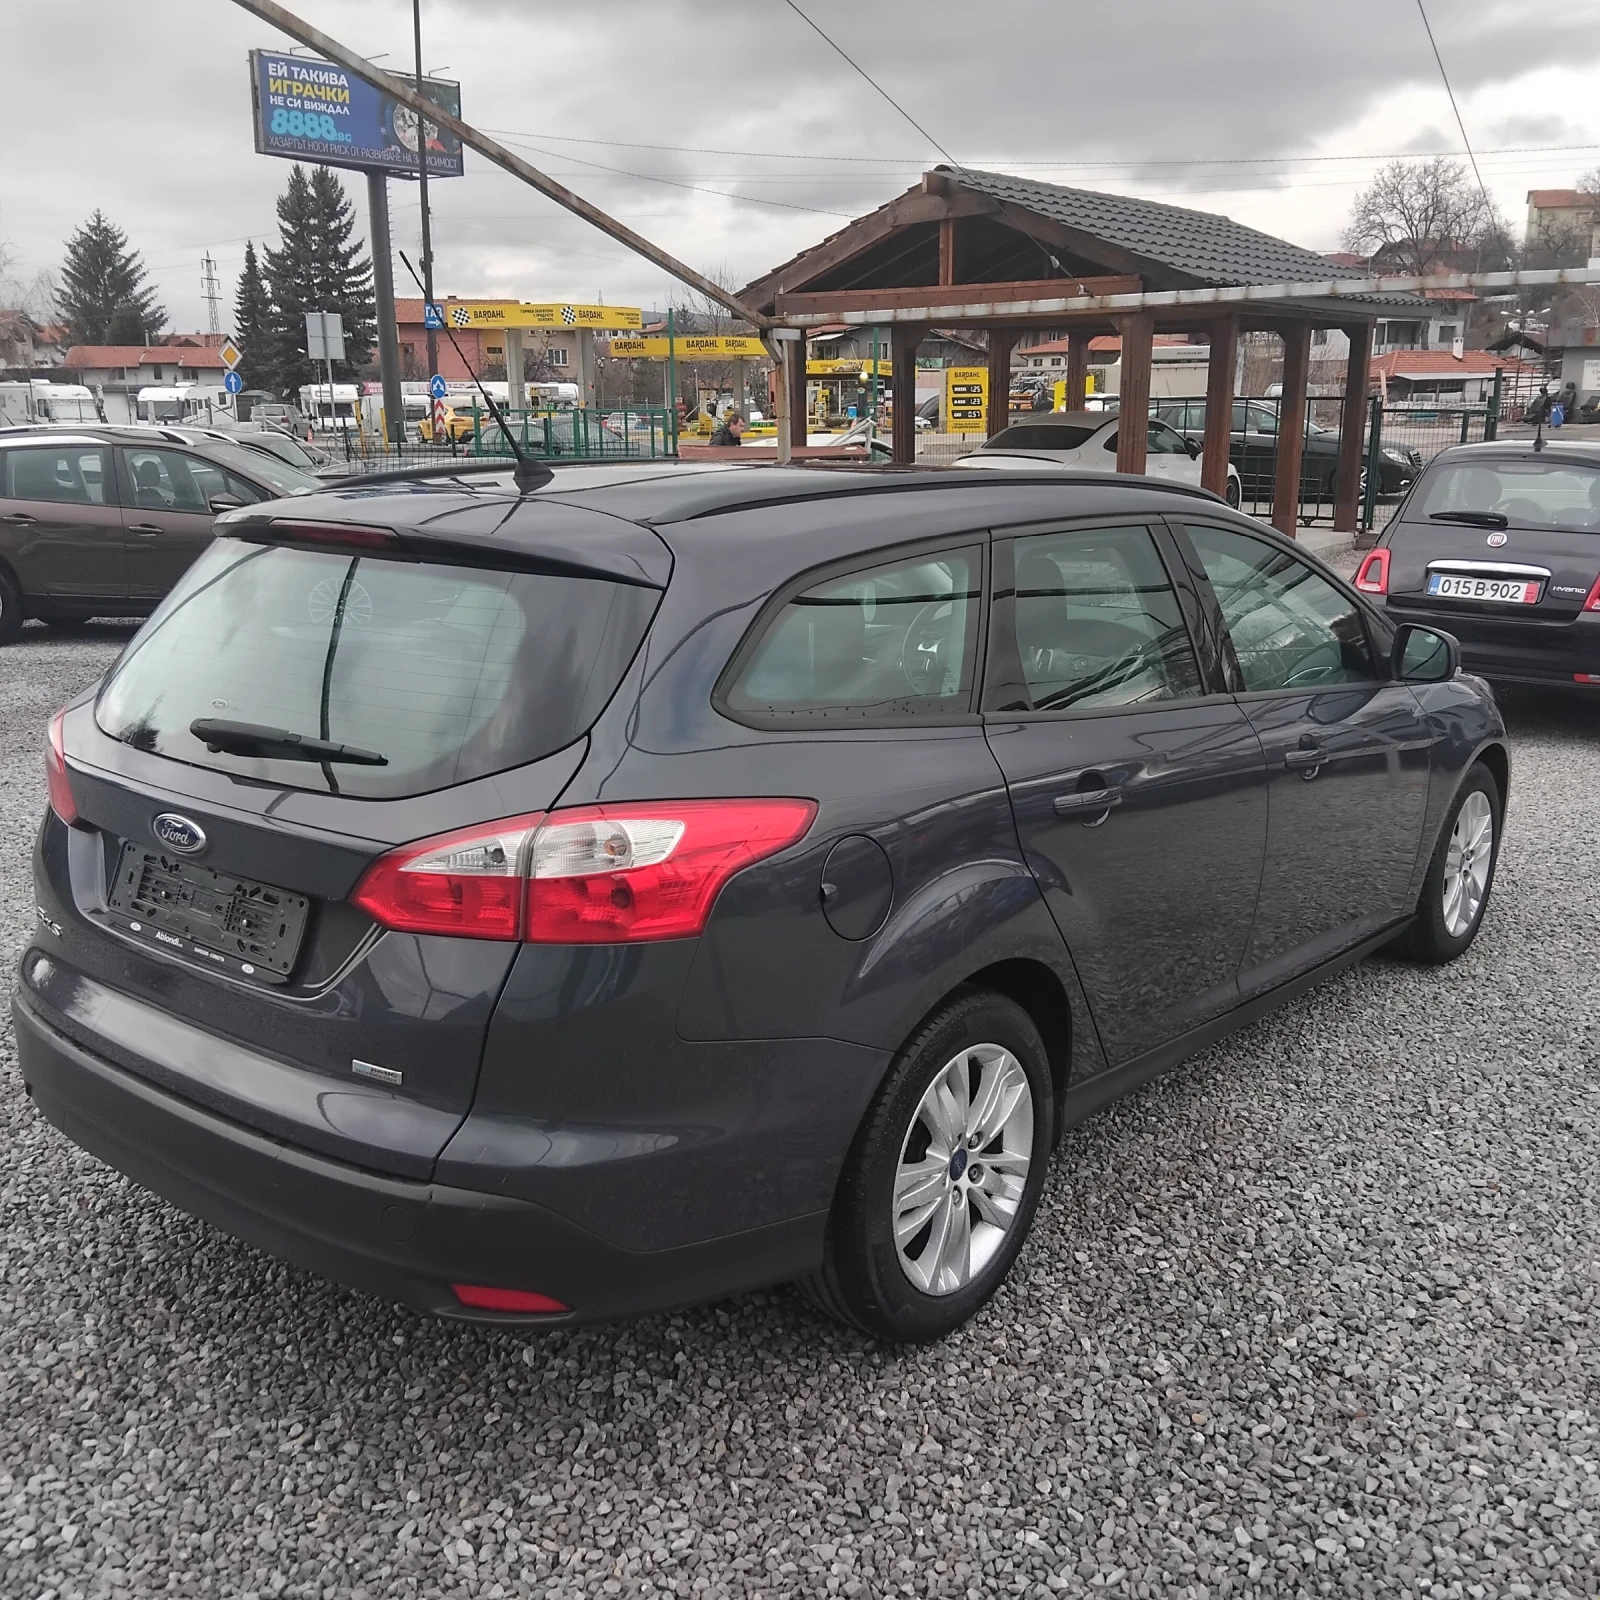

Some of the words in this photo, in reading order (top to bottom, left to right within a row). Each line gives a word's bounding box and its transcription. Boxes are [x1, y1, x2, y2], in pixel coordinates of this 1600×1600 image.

[268, 61, 288, 78] ЕЙ
[290, 66, 349, 87] ТАКИВА
[269, 78, 350, 104] ИГРАЧКИ
[269, 95, 285, 106] НЕ
[286, 97, 302, 109] СИ
[303, 100, 350, 116] ВИЖДАЛ
[269, 135, 307, 150] ХАЗАРТЪТ
[307, 140, 329, 152] НОСИ
[329, 143, 350, 155] РИСК
[350, 146, 360, 156] ОТ
[361, 147, 401, 162] РАЗВИВАНЕ
[402, 152, 413, 164] НА
[425, 305, 443, 318] ГАЗ
[474, 310, 505, 322] BARDAHL
[578, 310, 604, 322] BARDAHL
[614, 341, 645, 353] BARDAHL
[686, 340, 719, 351] BARDAHL
[725, 339, 748, 351] BARDAHL
[954, 371, 980, 380] BARDAHL
[161, 819, 190, 845] Ford
[155, 931, 180, 946] Ablondi
